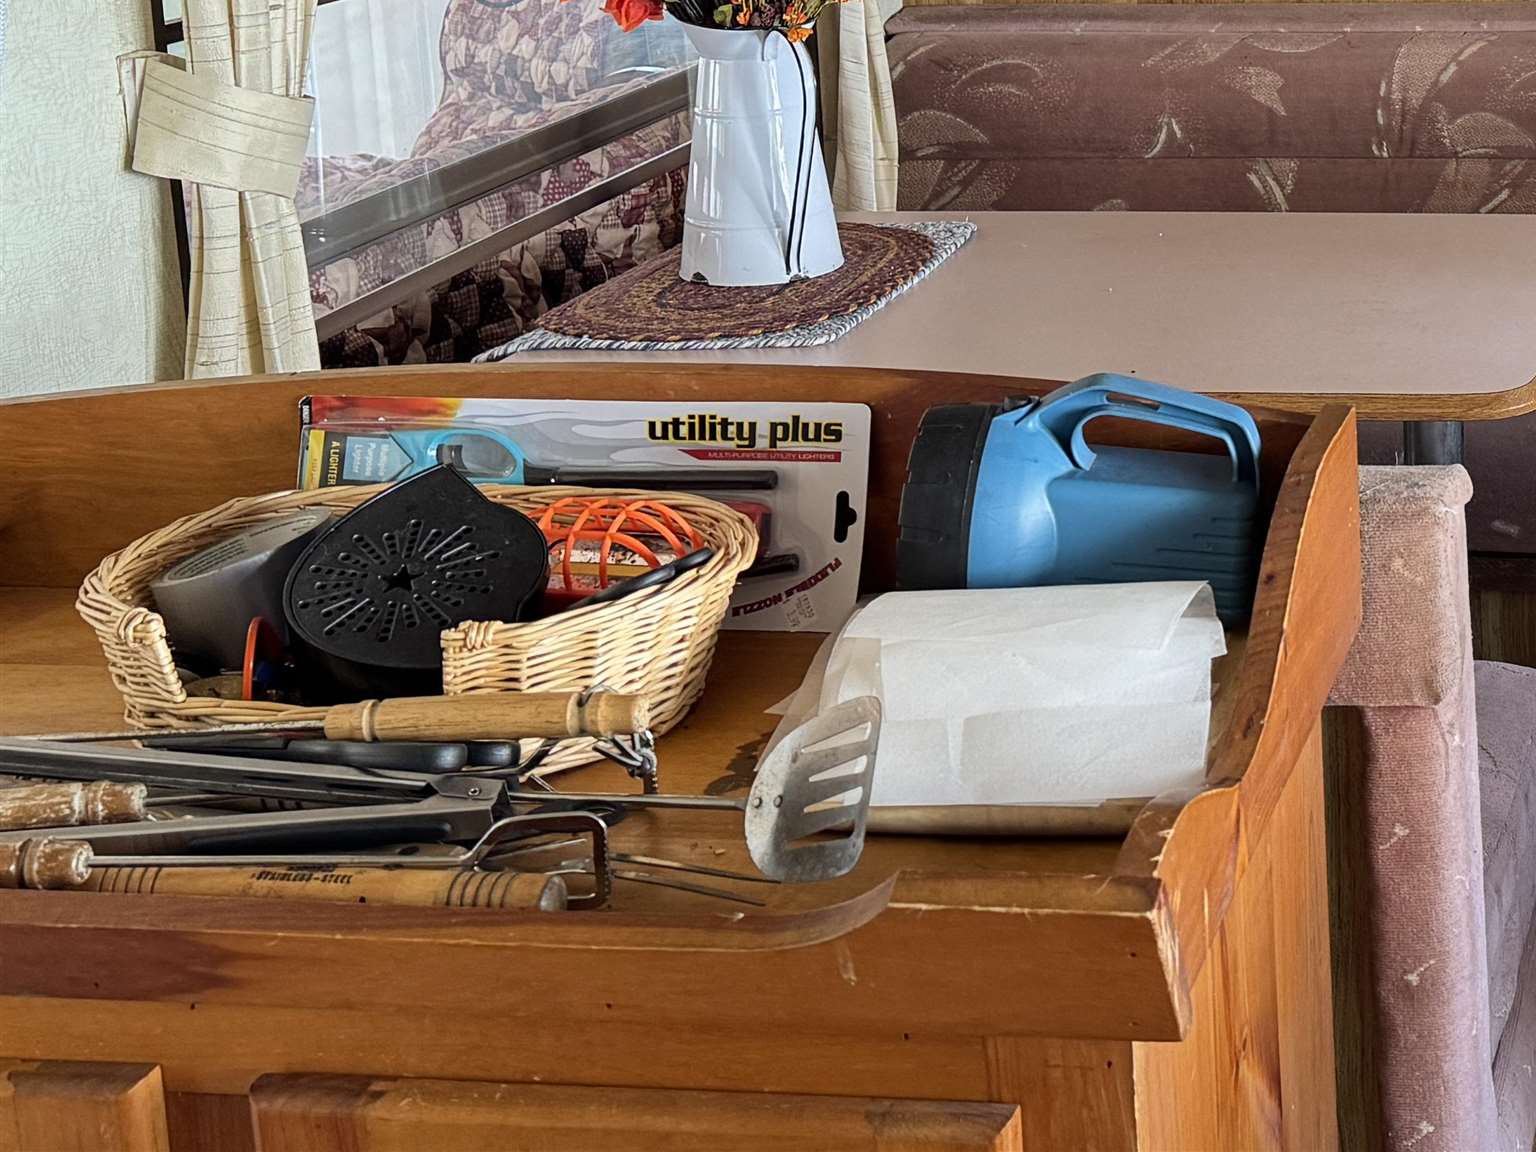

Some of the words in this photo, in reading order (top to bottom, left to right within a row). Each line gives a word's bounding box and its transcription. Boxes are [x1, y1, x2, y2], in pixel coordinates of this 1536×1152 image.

[647, 414, 757, 449] utility
[768, 414, 843, 449] plus
[327, 449, 340, 486] LIGHTER
[731, 592, 784, 618] NOZZLE
